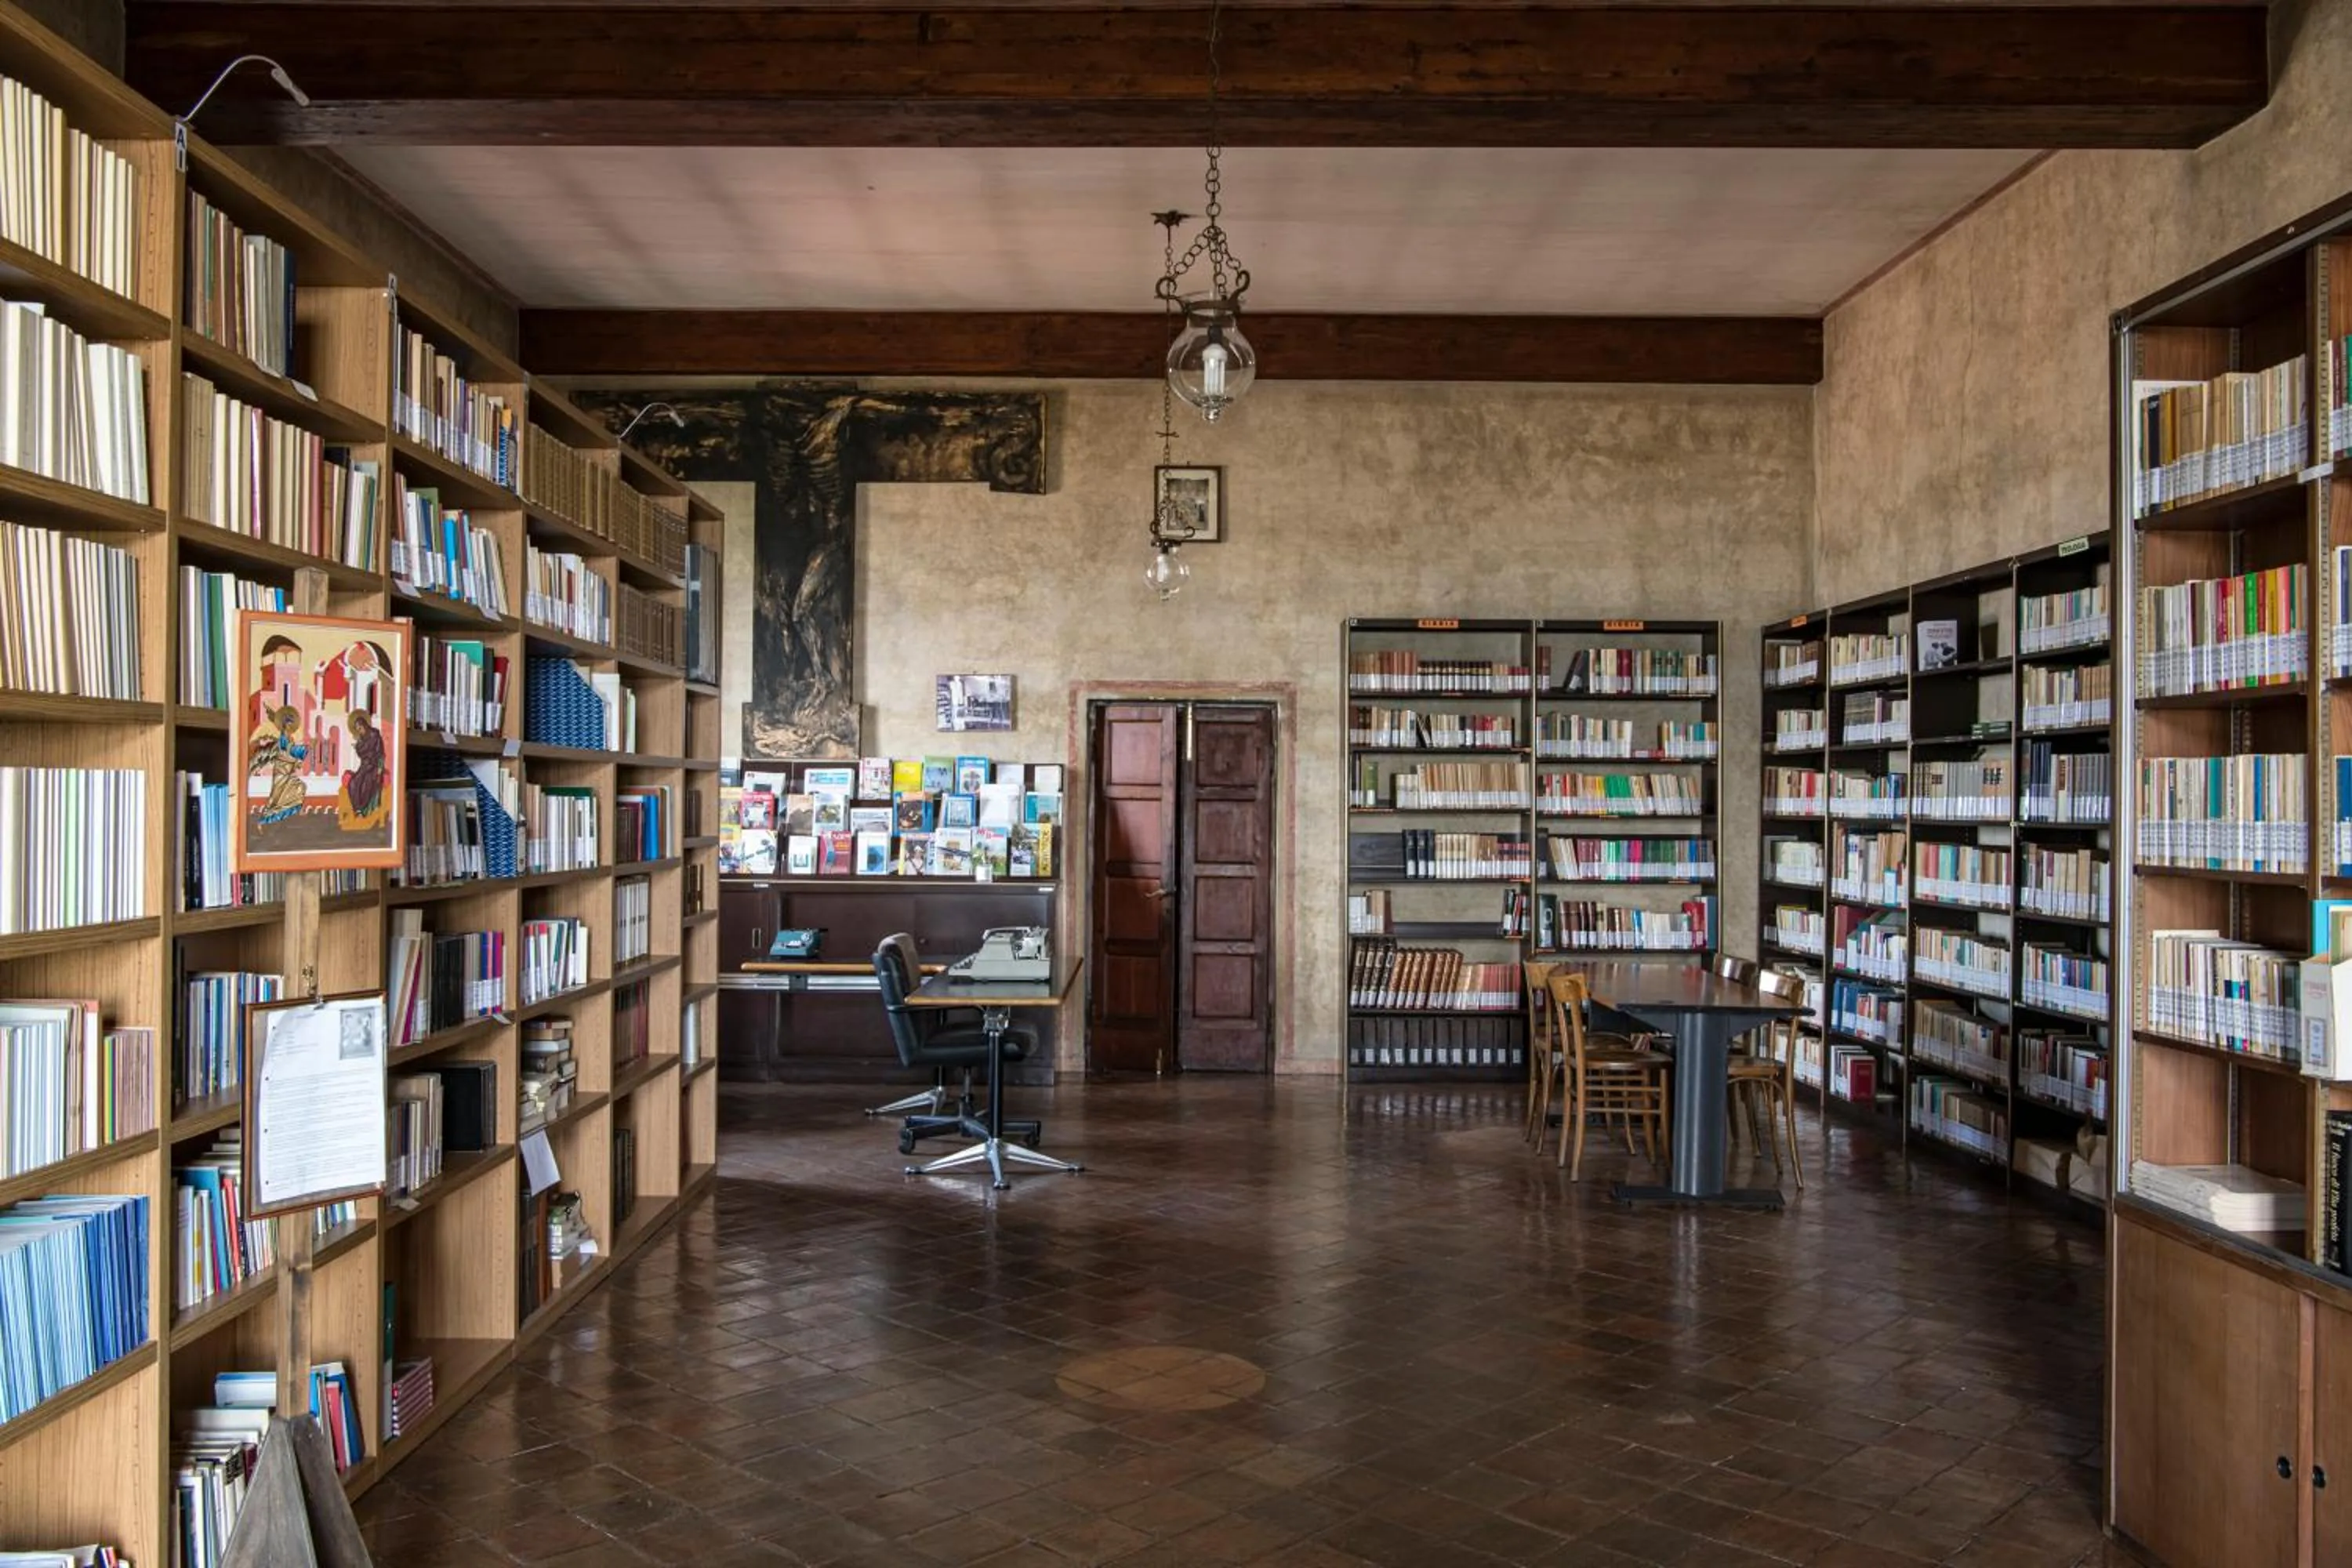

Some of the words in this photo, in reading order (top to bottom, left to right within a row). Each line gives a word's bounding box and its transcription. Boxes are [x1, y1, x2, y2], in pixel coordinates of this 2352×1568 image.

[176, 128, 185, 149] A
[2331, 1177, 2341, 1188] di
[2331, 1189, 2340, 1207] Elia
[2330, 1208, 2340, 1242] profeta
